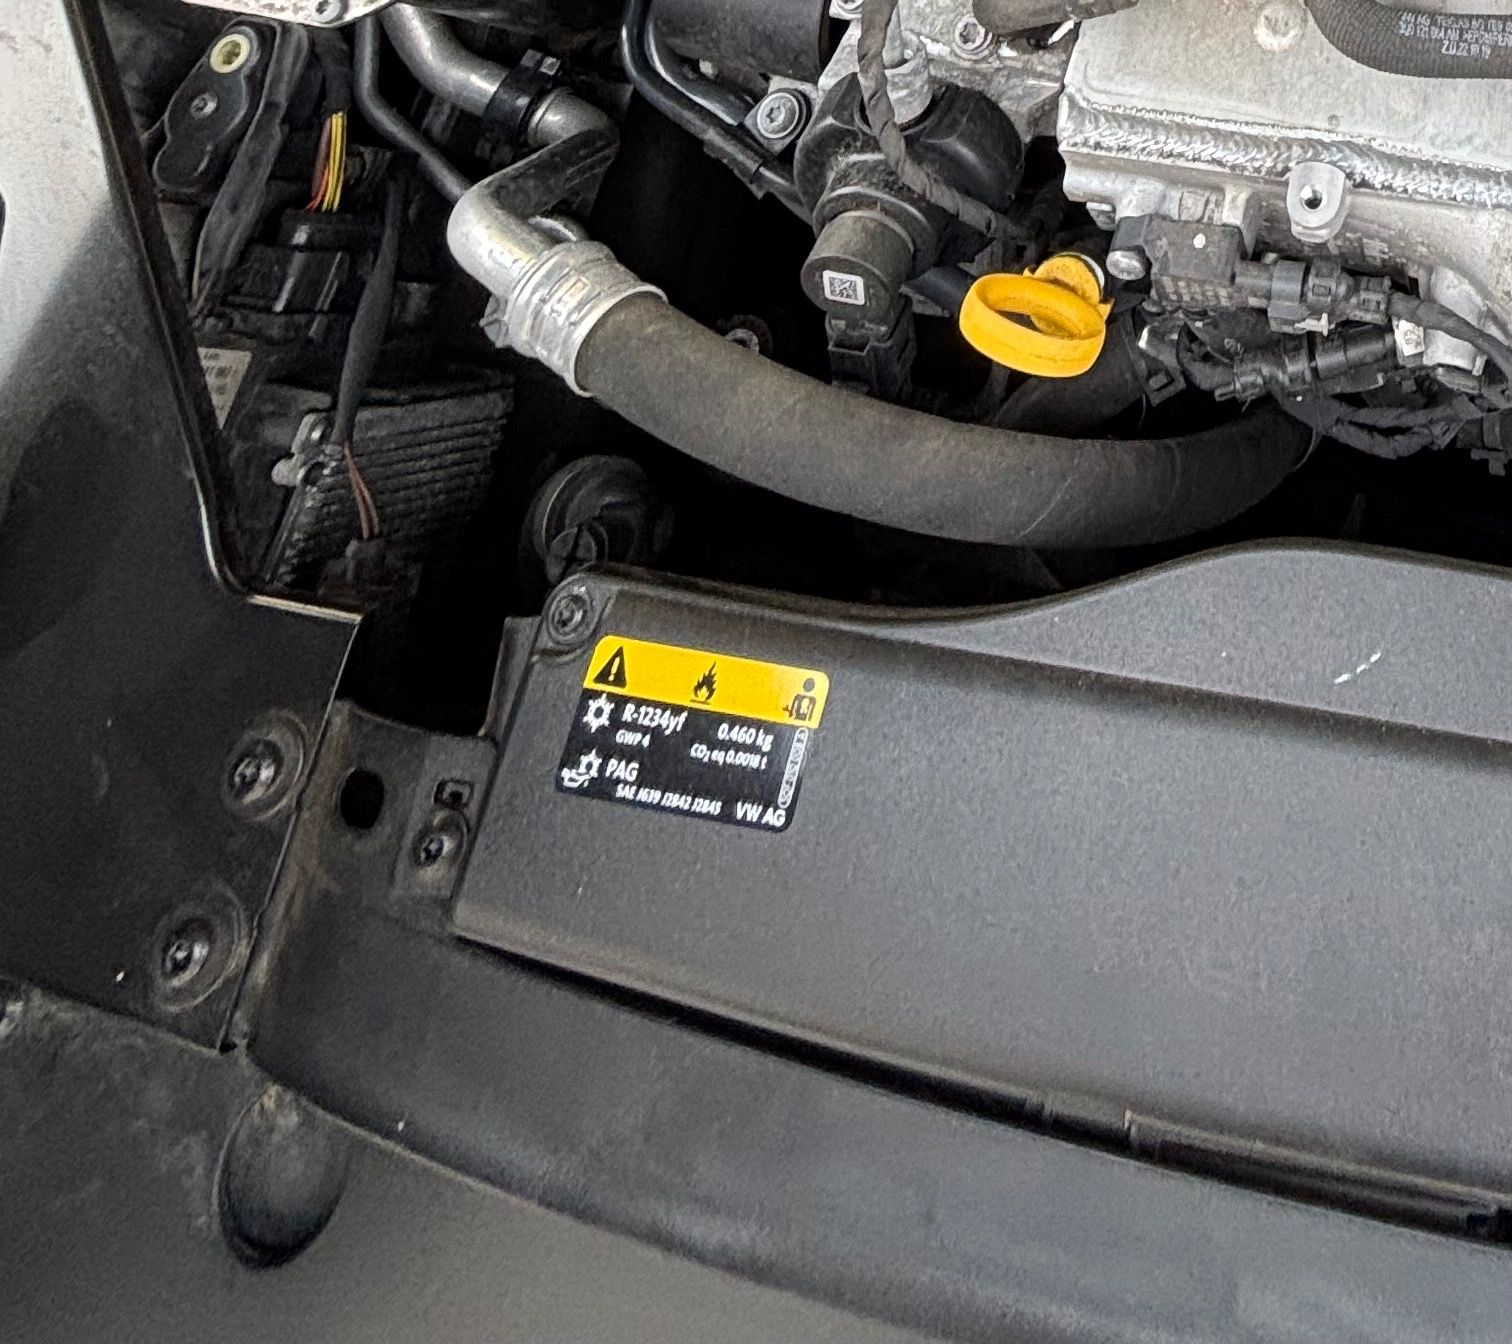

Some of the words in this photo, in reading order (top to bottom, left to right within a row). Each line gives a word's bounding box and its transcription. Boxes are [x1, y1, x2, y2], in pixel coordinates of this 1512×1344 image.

[615, 730, 642, 745] GWP
[641, 734, 650, 748] 4
[621, 703, 688, 736] R-1234yf
[717, 723, 755, 744] 0.460
[755, 727, 774, 752] kg
[605, 758, 640, 782] PAG
[615, 783, 636, 801] SAE
[736, 801, 763, 822] VW
[761, 807, 786, 827] AG
